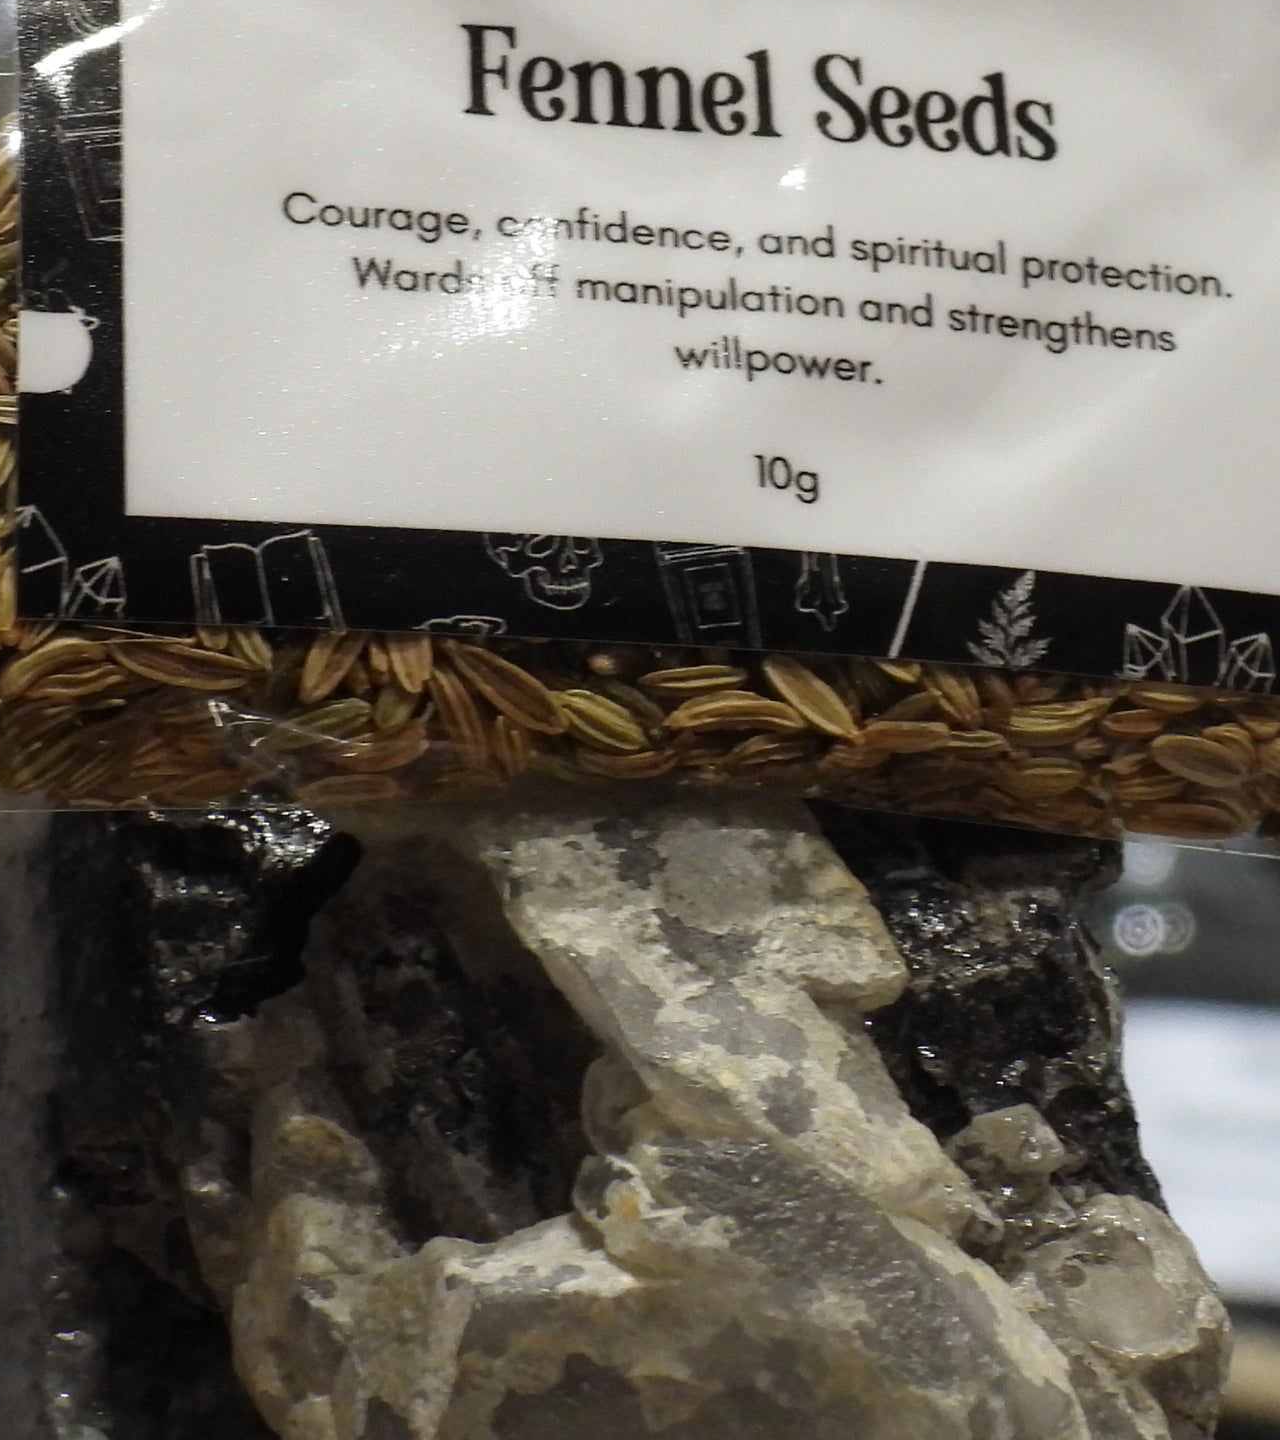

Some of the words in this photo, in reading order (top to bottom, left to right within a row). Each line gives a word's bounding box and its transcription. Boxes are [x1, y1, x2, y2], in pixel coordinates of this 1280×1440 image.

[460, 23, 782, 138] Fennel
[814, 52, 1058, 162] Seeds
[282, 191, 482, 243] Courage,
[758, 225, 836, 258] and
[850, 237, 1007, 275] spiritual
[1021, 253, 1234, 298] protection.
[498, 262, 560, 298] ff
[577, 276, 845, 318] manipulation
[859, 293, 933, 328] and
[948, 304, 1178, 354] strengthens
[674, 335, 883, 385] willpower.
[753, 455, 819, 504] 10g
